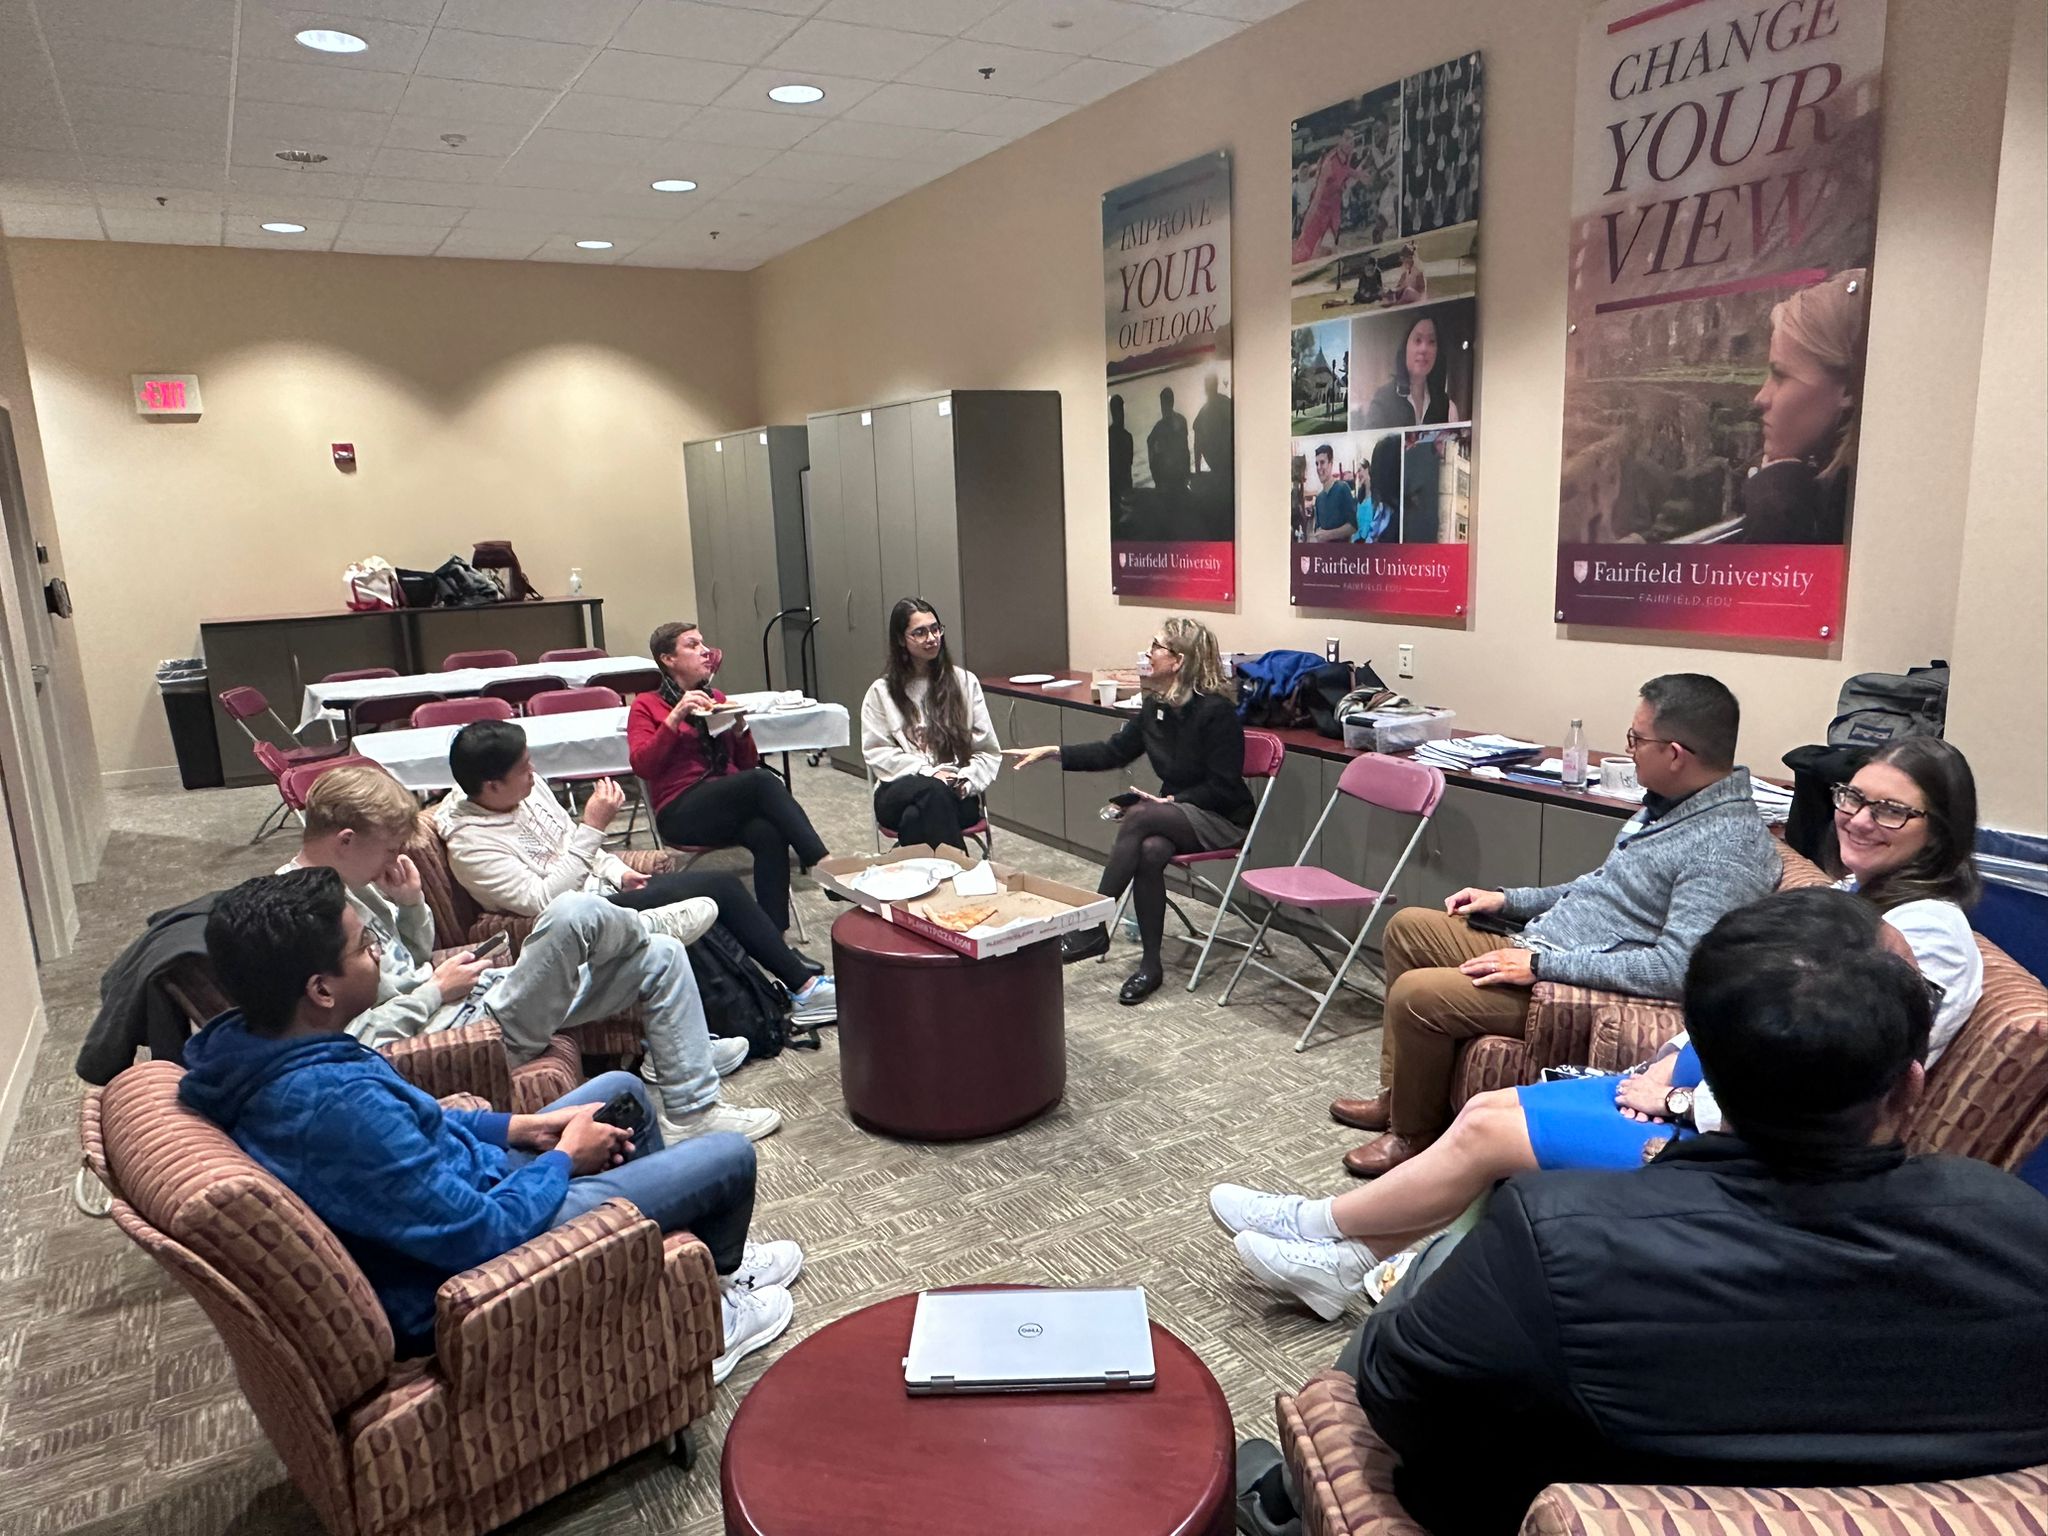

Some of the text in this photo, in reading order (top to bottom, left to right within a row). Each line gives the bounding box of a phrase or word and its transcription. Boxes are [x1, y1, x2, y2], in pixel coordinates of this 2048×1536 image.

[1609, 0, 1840, 101] CHANGE
[1603, 62, 1842, 196] YOUR
[1120, 199, 1212, 251] IMPROVE
[1601, 168, 1834, 285] VIEW
[1120, 243, 1217, 313] YOUR
[1119, 304, 1217, 350] OUTLOOK
[1128, 553, 1221, 575] Fairfield University
[1314, 556, 1451, 583] Fairfield University
[1594, 561, 1814, 595] Fairfield University
[1638, 593, 1733, 607] FAIRFIELD.EDU
